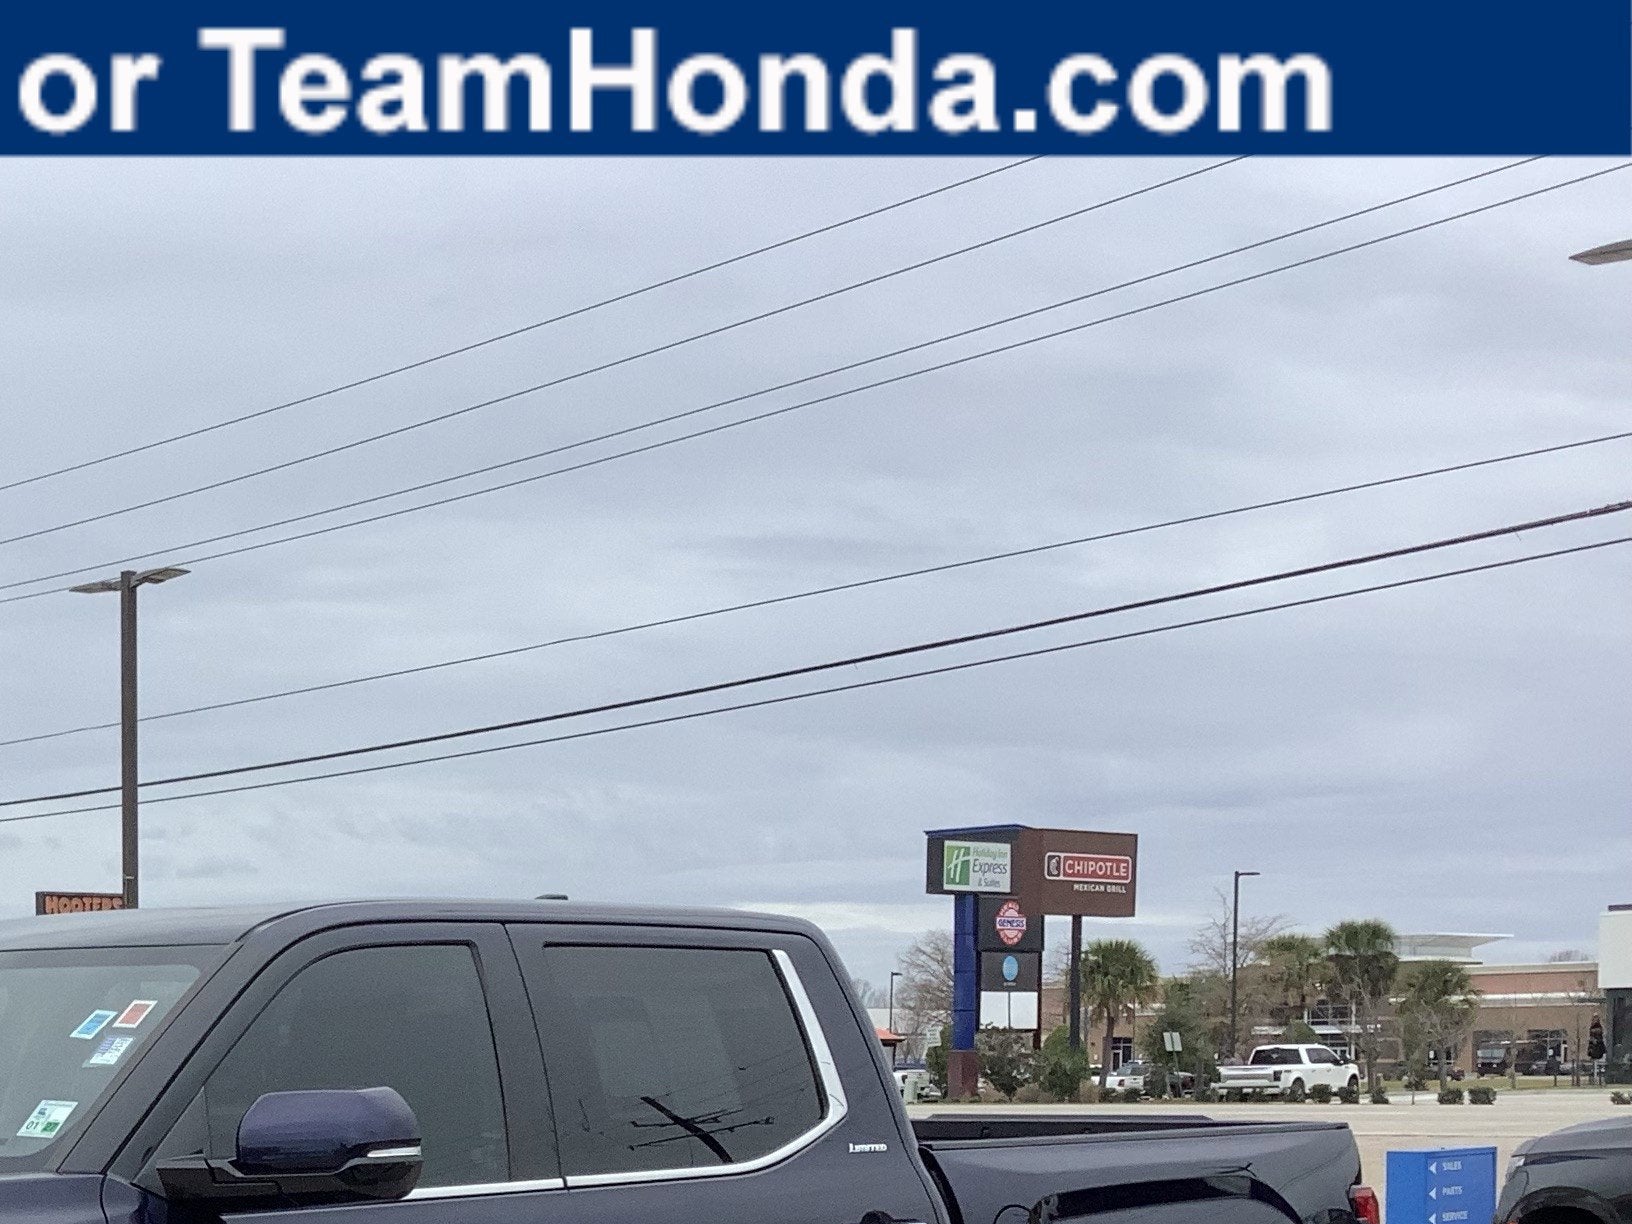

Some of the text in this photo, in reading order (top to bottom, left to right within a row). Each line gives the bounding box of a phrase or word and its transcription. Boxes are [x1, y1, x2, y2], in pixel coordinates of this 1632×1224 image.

[973, 858, 1007, 876] Express
[1065, 860, 1128, 877] CHIPOTLE
[1073, 884, 1105, 892] MEXICAN
